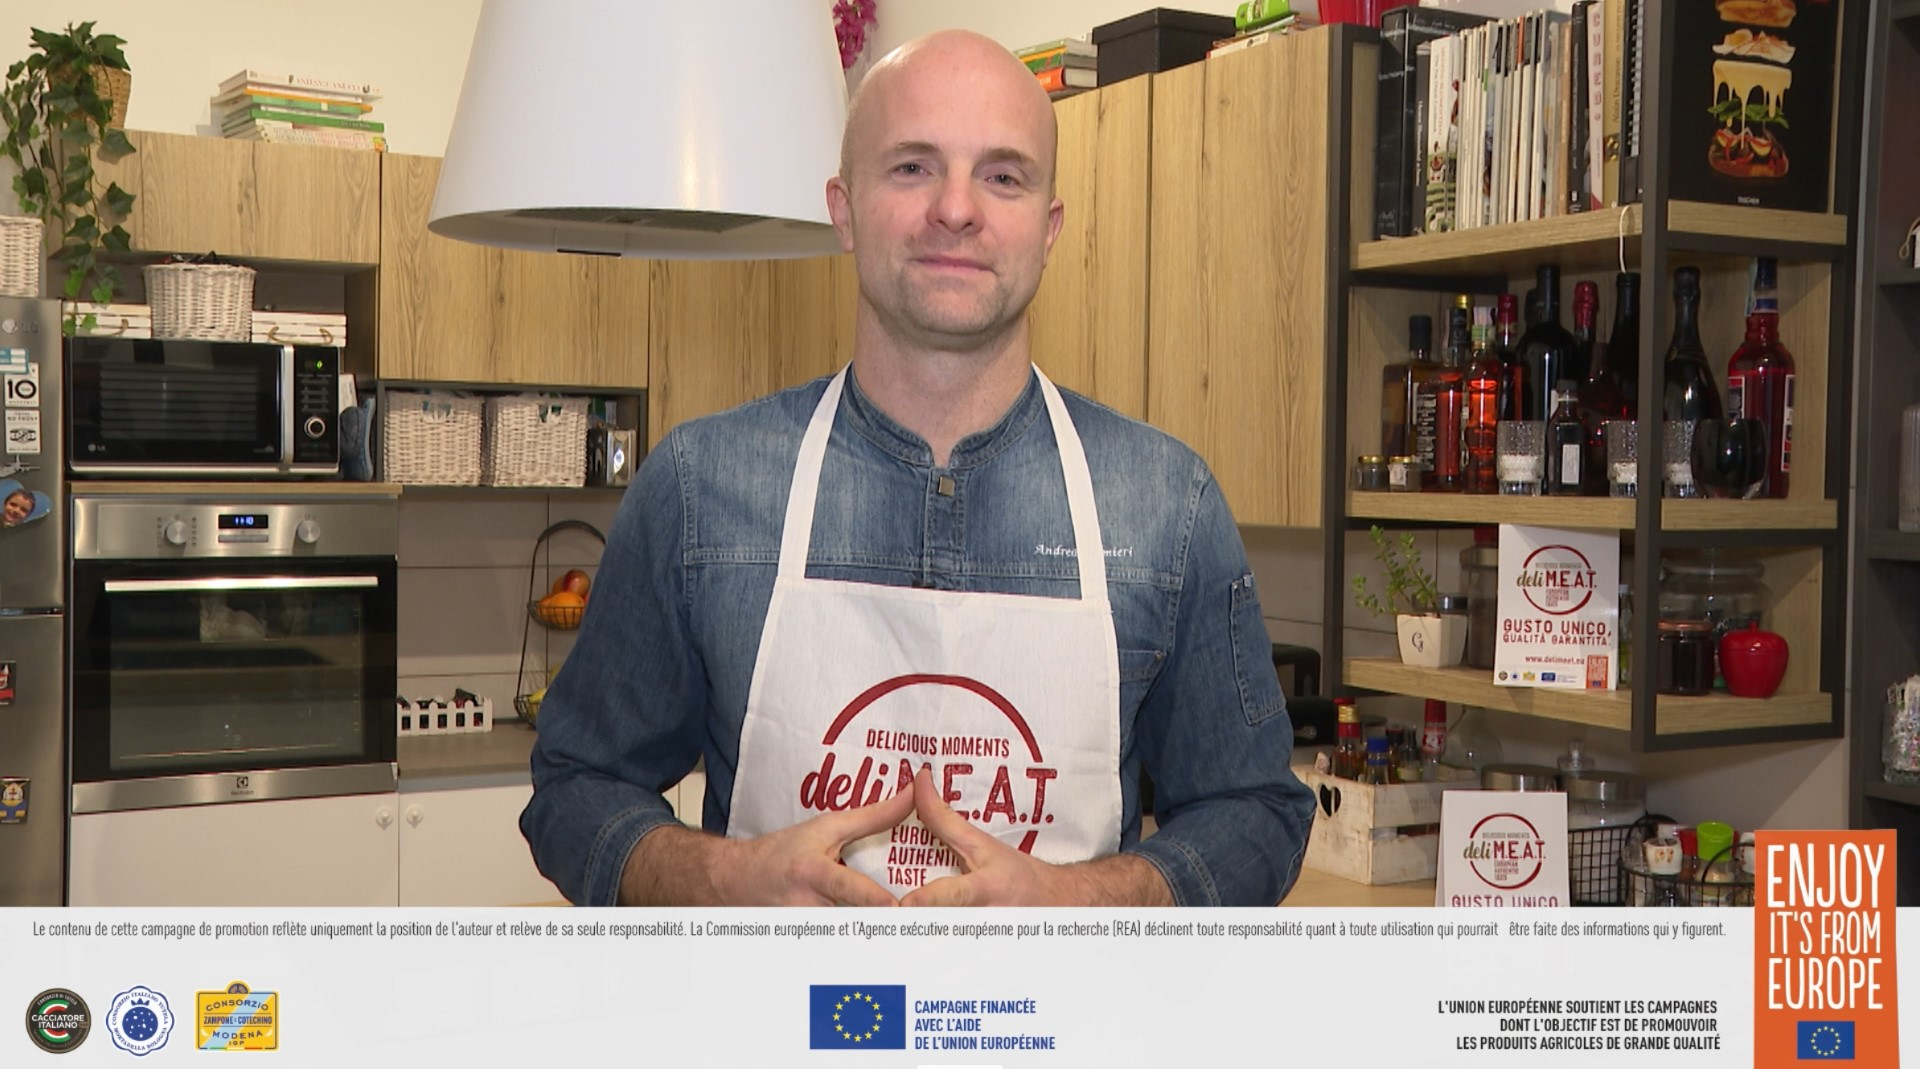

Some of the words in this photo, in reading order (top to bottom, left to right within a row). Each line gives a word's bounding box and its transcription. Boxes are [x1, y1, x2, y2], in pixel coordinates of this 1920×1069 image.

[7, 379, 37, 399] 10
[1503, 618, 1553, 633] GUSTO
[1561, 620, 1612, 637] UNICO,
[1411, 631, 1424, 653] G
[866, 728, 937, 756] DELICIOUS
[941, 736, 1010, 758] MOMENTS
[887, 866, 927, 887] TASTE
[1451, 895, 1504, 907] GUSTO
